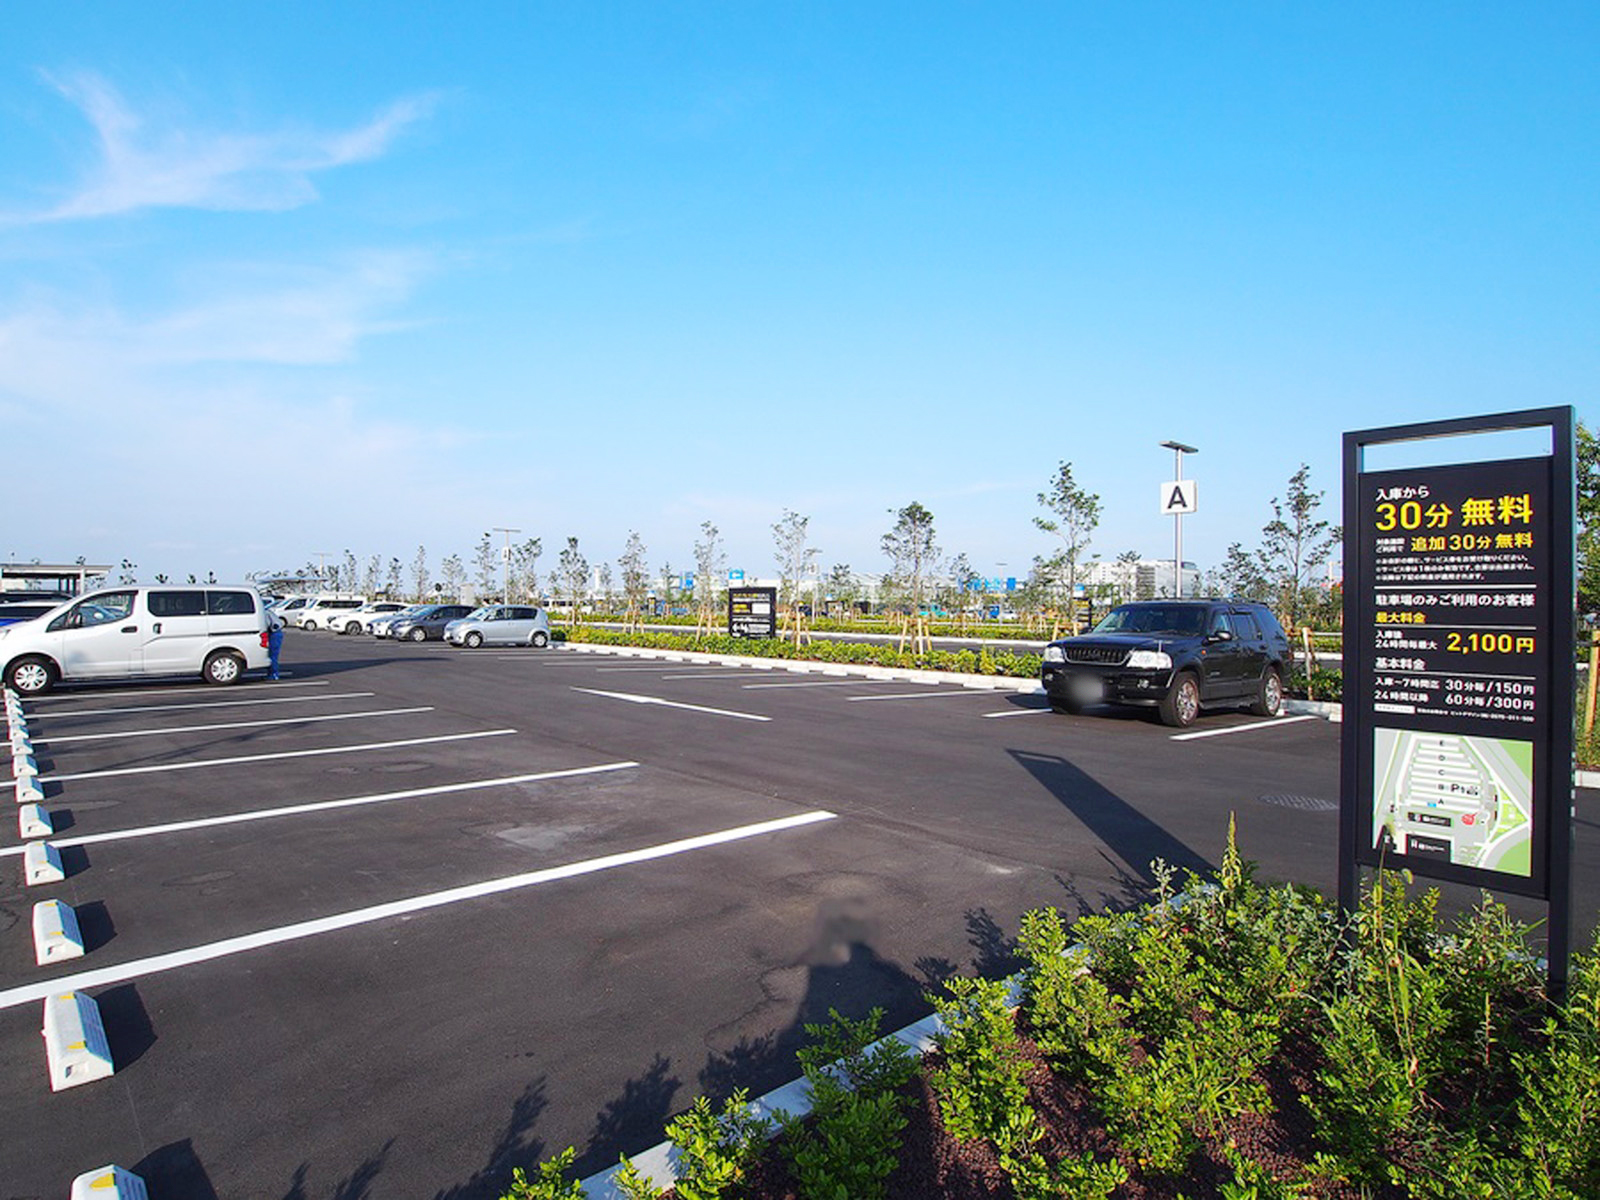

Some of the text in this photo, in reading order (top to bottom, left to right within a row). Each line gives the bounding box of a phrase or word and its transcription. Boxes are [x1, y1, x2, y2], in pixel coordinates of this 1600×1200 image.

[1167, 485, 1187, 509] A
[1375, 486, 1430, 501] 入庫から
[1375, 494, 1534, 531] 30分 無料
[1375, 594, 1535, 607] 駐車場のみご利用のお客様
[1375, 611, 1427, 624] 最大料金
[1447, 632, 1535, 655] 2,100円
[1375, 657, 1426, 671] 基本料金
